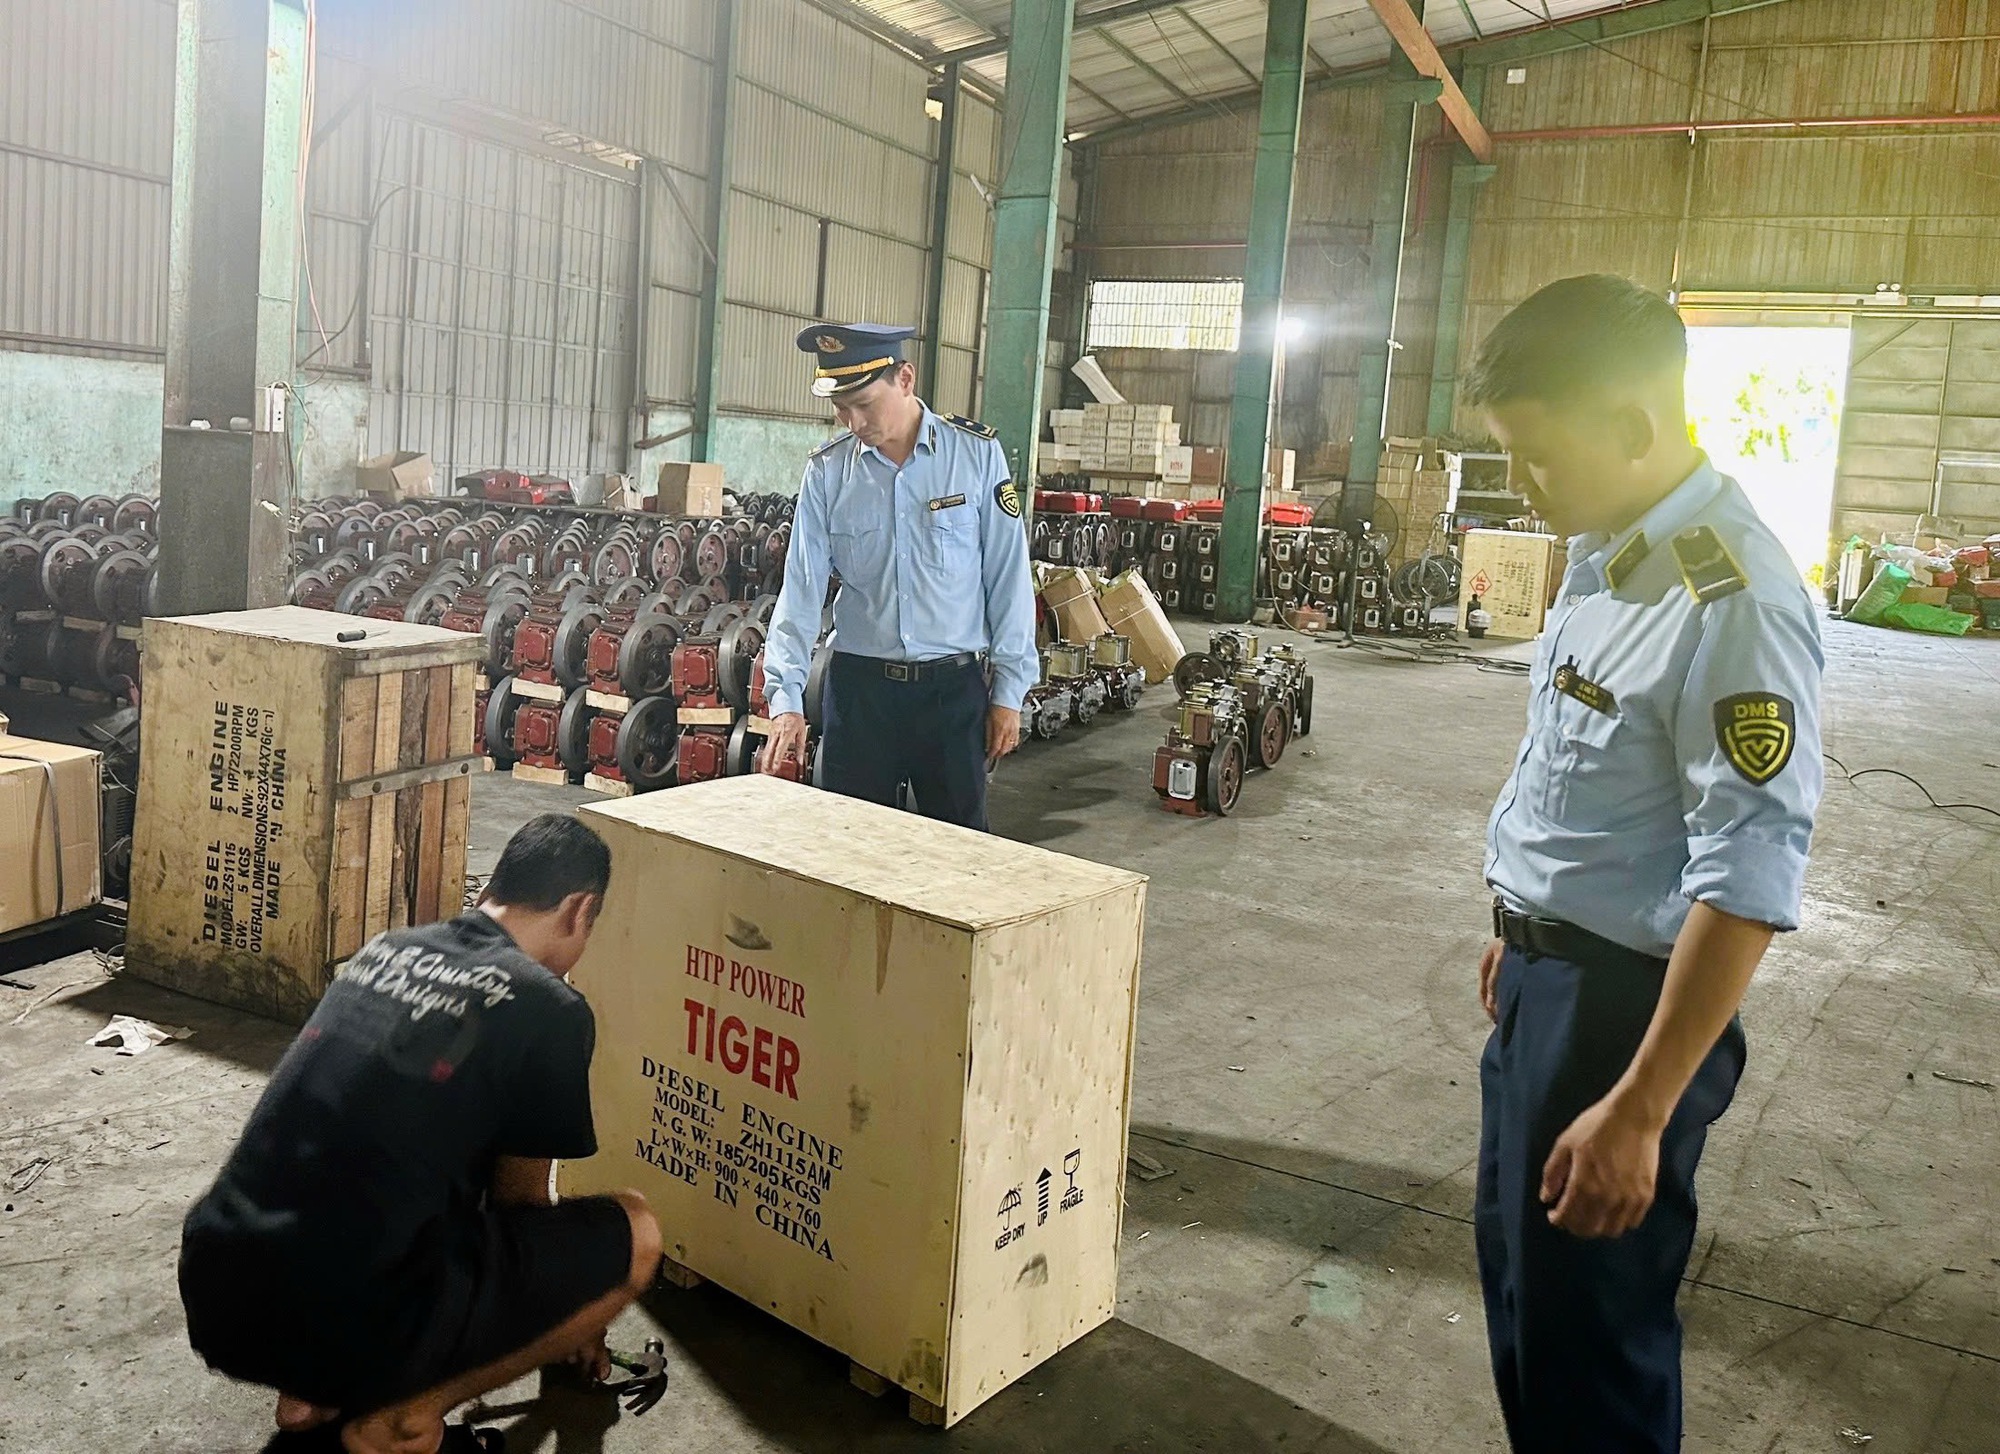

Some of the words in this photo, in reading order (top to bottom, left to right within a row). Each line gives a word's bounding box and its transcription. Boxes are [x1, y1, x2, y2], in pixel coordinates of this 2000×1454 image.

[1475, 576, 1486, 591] DF
[245, 707, 259, 738] KGS
[1734, 701, 1779, 719] DMS
[209, 701, 228, 812] ENGINE
[227, 705, 244, 792] HP/2200RPM
[242, 788, 254, 818] NW:
[271, 748, 287, 811] CHINA
[202, 840, 220, 941] DIESEL
[238, 847, 251, 878] KGS
[238, 884, 249, 893] 5
[266, 860, 280, 919] MADE
[235, 919, 248, 949] GW:
[250, 893, 264, 953] OVERALL
[685, 944, 725, 986] HTP
[728, 959, 806, 1019] POWER
[684, 998, 800, 1101] TIGER
[641, 1056, 725, 1113] DIESEL
[741, 1102, 843, 1171] ENGINE
[655, 1086, 715, 1129] MODEL:
[739, 1129, 831, 1191] ZH1115AM
[635, 1138, 698, 1187] MADE
[713, 1179, 739, 1209] IN
[755, 1203, 834, 1262] CHINA
[714, 1160, 738, 1186] 900
[754, 1182, 779, 1207] 440
[796, 1202, 821, 1230] 760
[1037, 1210, 1048, 1227] UP
[1059, 1189, 1084, 1214] FRAGILE
[994, 1230, 1012, 1252] KEEP
[1012, 1222, 1026, 1242] DRY
